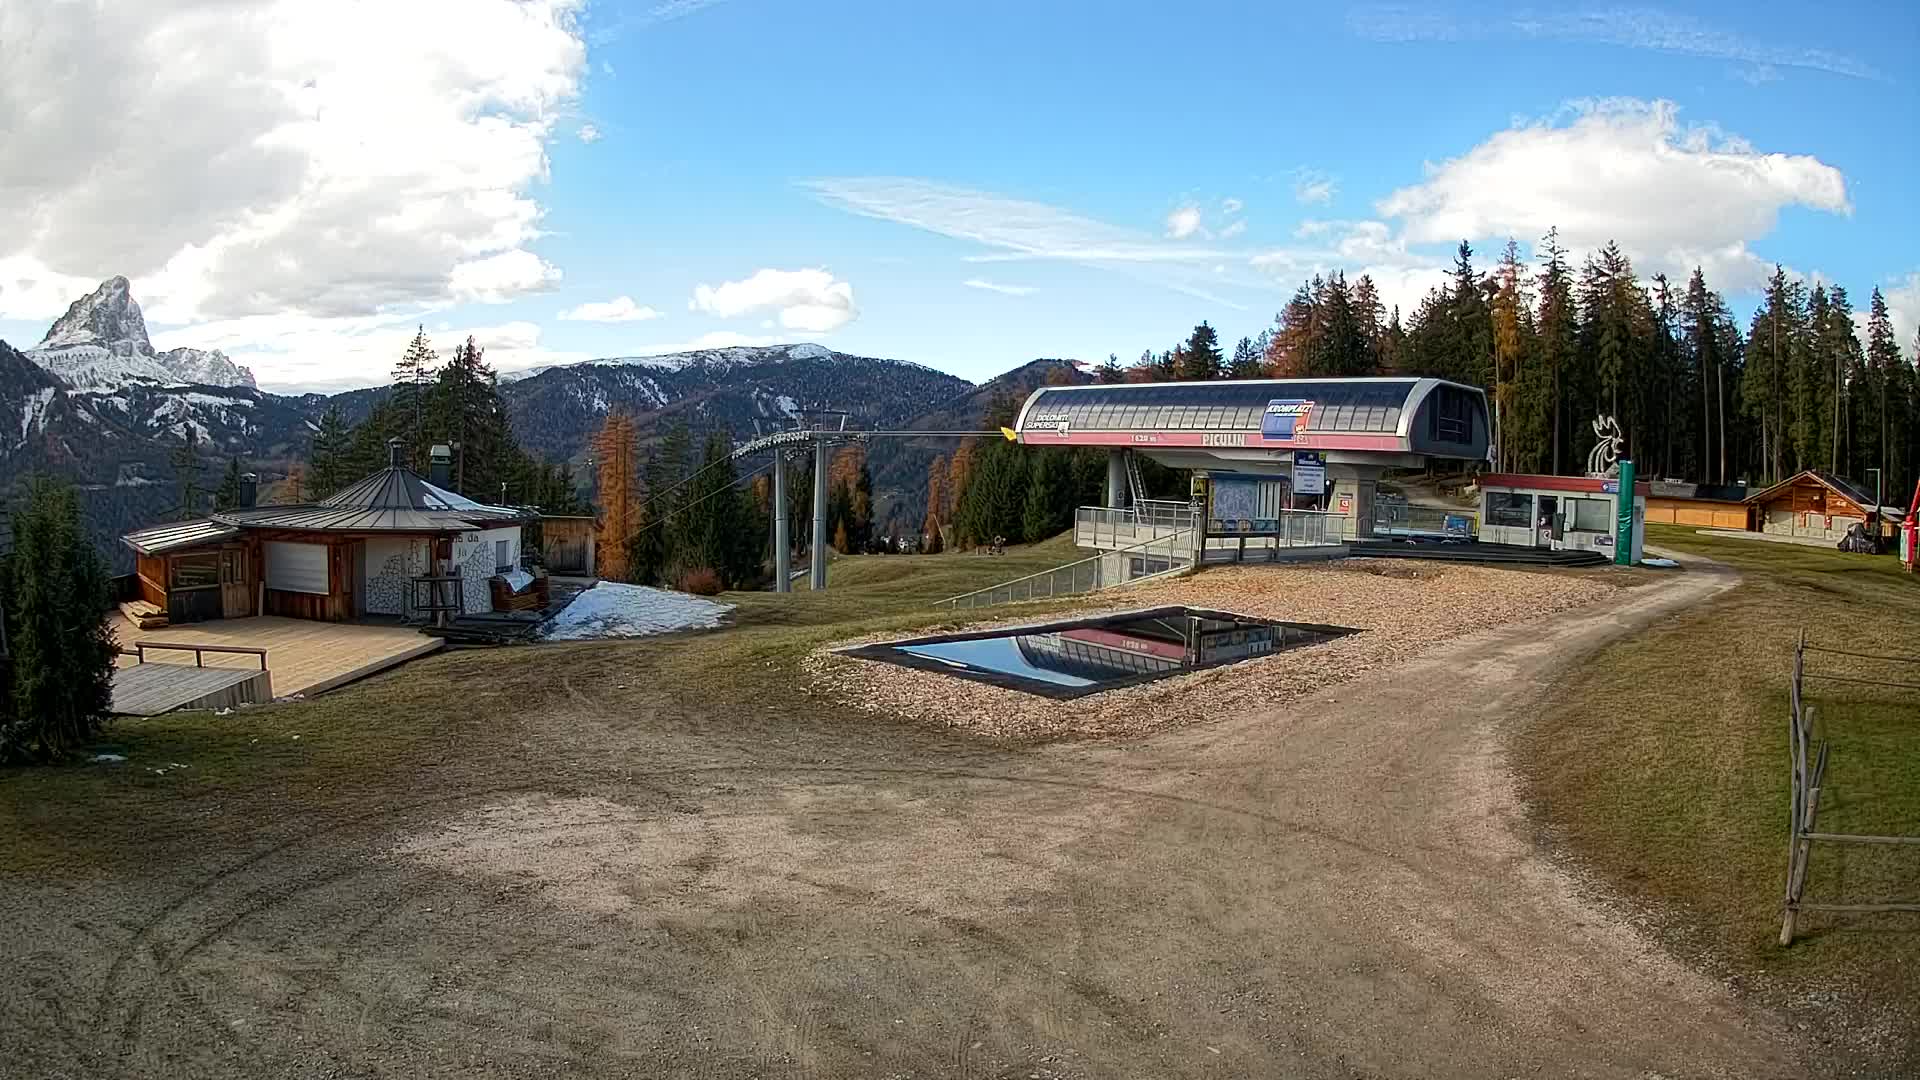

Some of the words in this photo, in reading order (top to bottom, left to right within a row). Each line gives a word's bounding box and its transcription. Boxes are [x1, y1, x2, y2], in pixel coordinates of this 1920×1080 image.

[1266, 404, 1312, 413] KRONPLATZ
[1025, 421, 1059, 429] SUPERSKI
[1202, 433, 1246, 447] PICULIN
